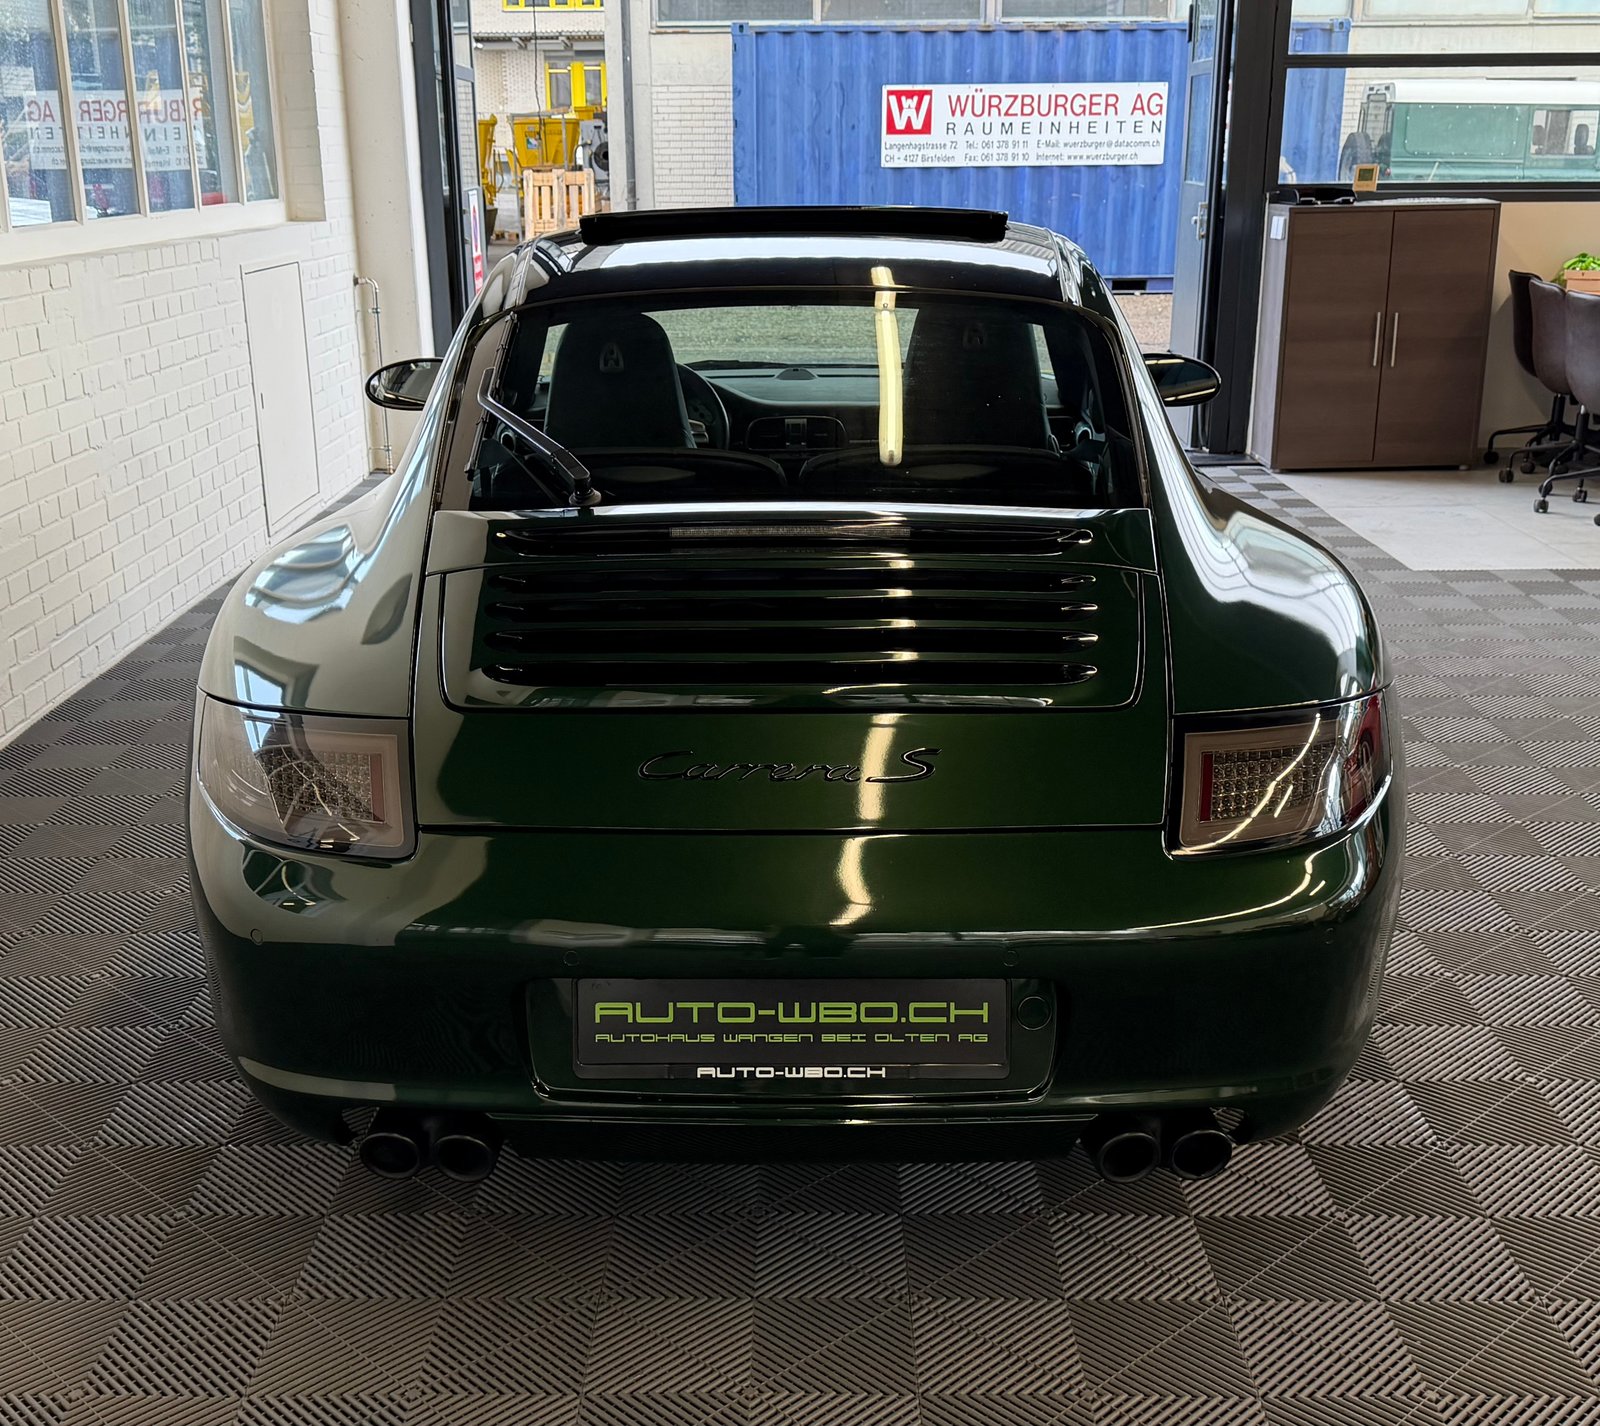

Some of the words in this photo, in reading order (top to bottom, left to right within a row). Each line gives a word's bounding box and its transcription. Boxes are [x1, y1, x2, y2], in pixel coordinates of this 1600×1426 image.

[948, 88, 1119, 118] WÜRZBURGER
[1130, 92, 1164, 117] AG
[946, 120, 1163, 136] RAUMEINHEITEN
[884, 141, 947, 152] Langenhagstrasse
[949, 141, 958, 150] 72
[981, 140, 994, 150] 061
[996, 140, 1009, 150] 378
[1011, 140, 1020, 149] 91
[1022, 140, 1029, 149] 11
[884, 154, 895, 163] CH
[903, 153, 919, 163] 4127
[921, 153, 955, 163] Birsfelden
[964, 153, 978, 162] Fax:
[980, 153, 994, 162] 061
[996, 153, 1009, 162] 378
[1011, 153, 1020, 162] 91
[1022, 152, 1030, 161] 10
[1067, 151, 1139, 162] www.wuerzburger.ch
[637, 749, 862, 783] Carrera
[864, 747, 943, 784] S
[594, 1001, 989, 1024] AUTO-WBO.CH
[594, 1033, 716, 1043] AUTOHAUS
[722, 1033, 814, 1043] WANGEN
[821, 1033, 867, 1043] BEI
[874, 1033, 951, 1043] OLTEN
[957, 1033, 989, 1043] AG
[696, 1066, 886, 1079] AUTO-WBO.CH
